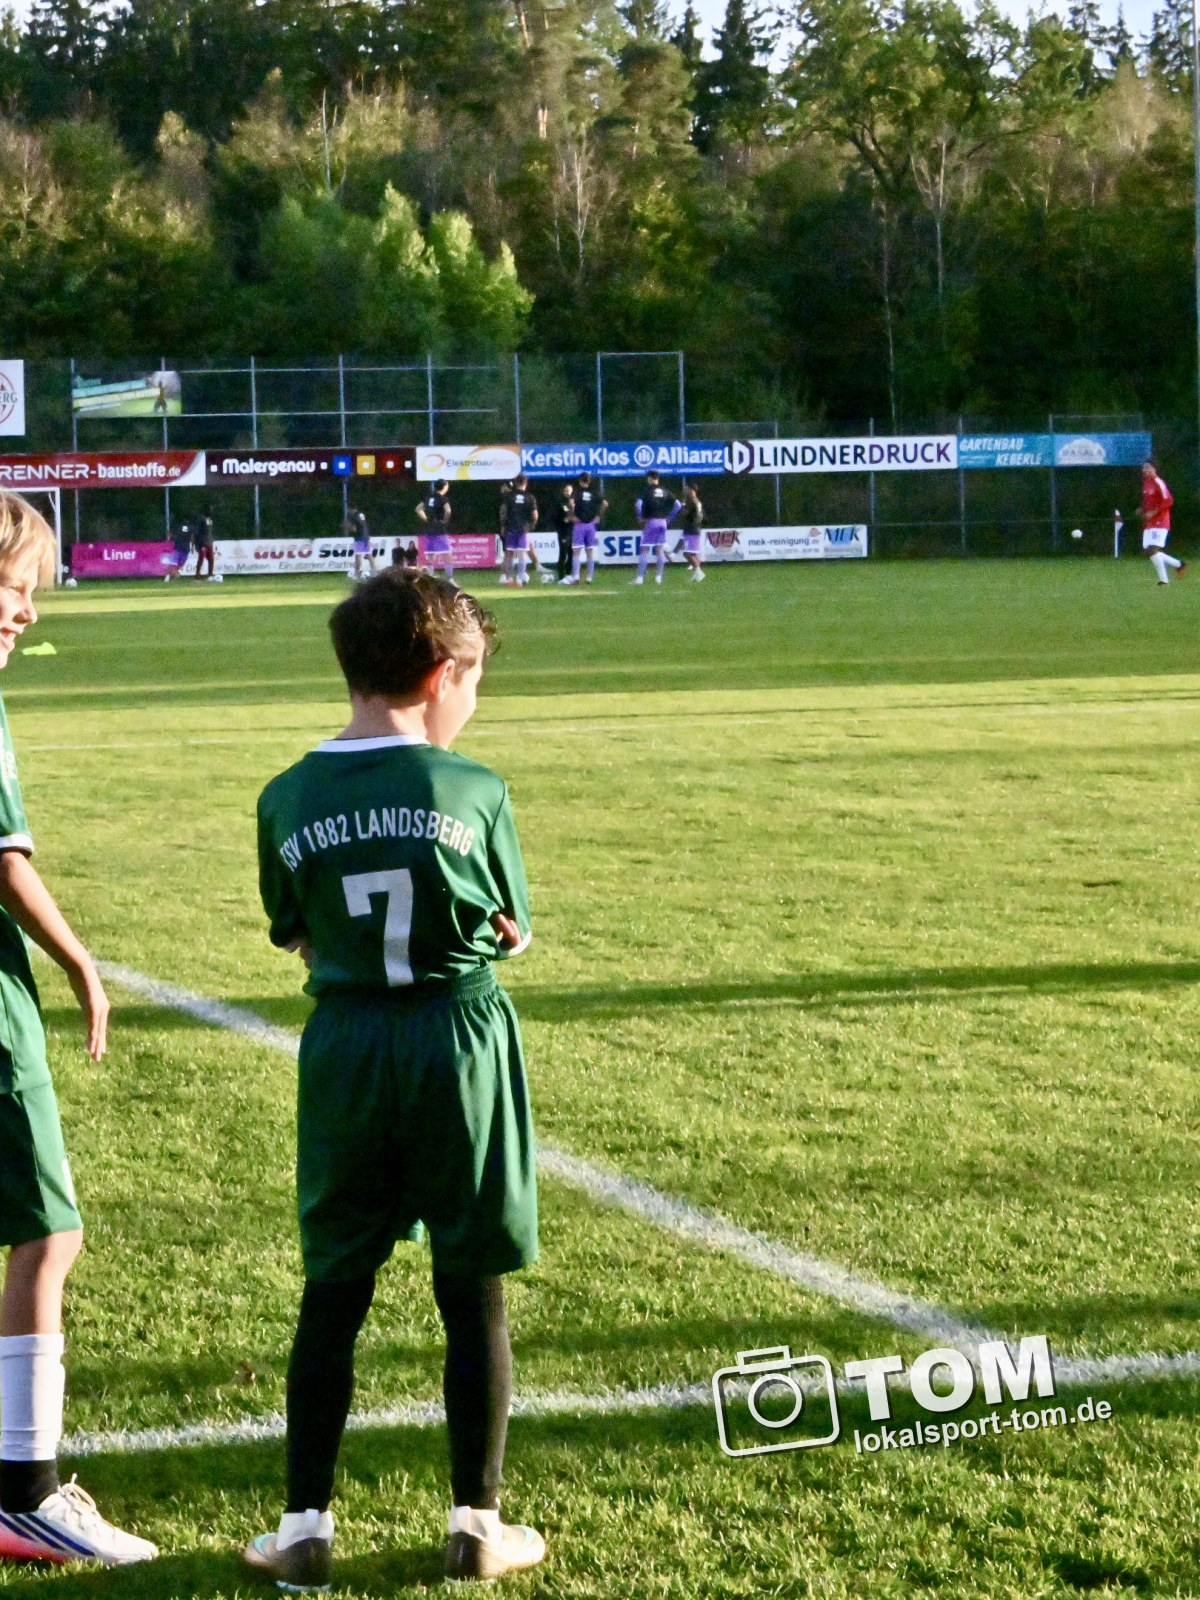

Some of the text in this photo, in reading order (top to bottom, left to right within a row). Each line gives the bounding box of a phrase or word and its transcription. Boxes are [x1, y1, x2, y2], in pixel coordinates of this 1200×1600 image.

[521, 446, 724, 467] Kerstin Klos Allianz
[759, 442, 952, 467] LINDNERDRUCK
[222, 457, 316, 476] Malergenau
[104, 549, 137, 561] Liner
[253, 545, 313, 560] auto
[303, 814, 351, 852] 1882
[354, 808, 476, 857] LANDSBERG
[342, 868, 415, 987] 7
